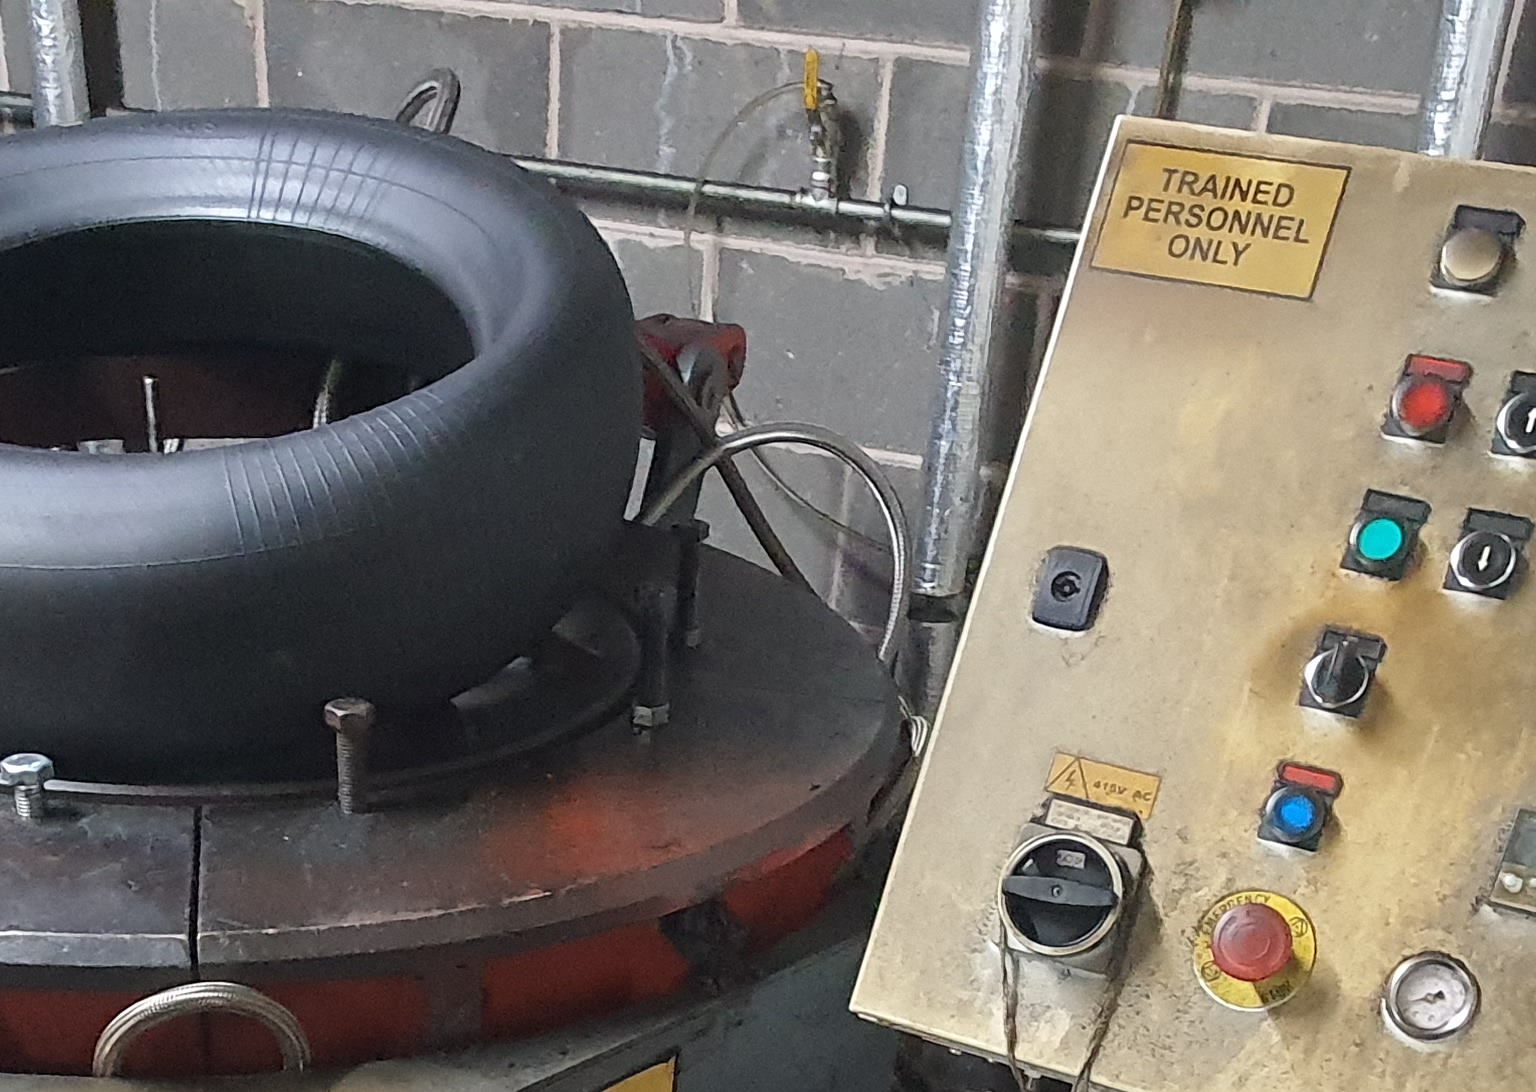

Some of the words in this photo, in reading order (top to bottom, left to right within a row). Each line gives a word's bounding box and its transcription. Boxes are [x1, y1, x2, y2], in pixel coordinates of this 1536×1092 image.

[1162, 167, 1295, 208] TRAINED
[1122, 196, 1310, 244] PERSONNEL
[1167, 233, 1252, 267] ONLY
